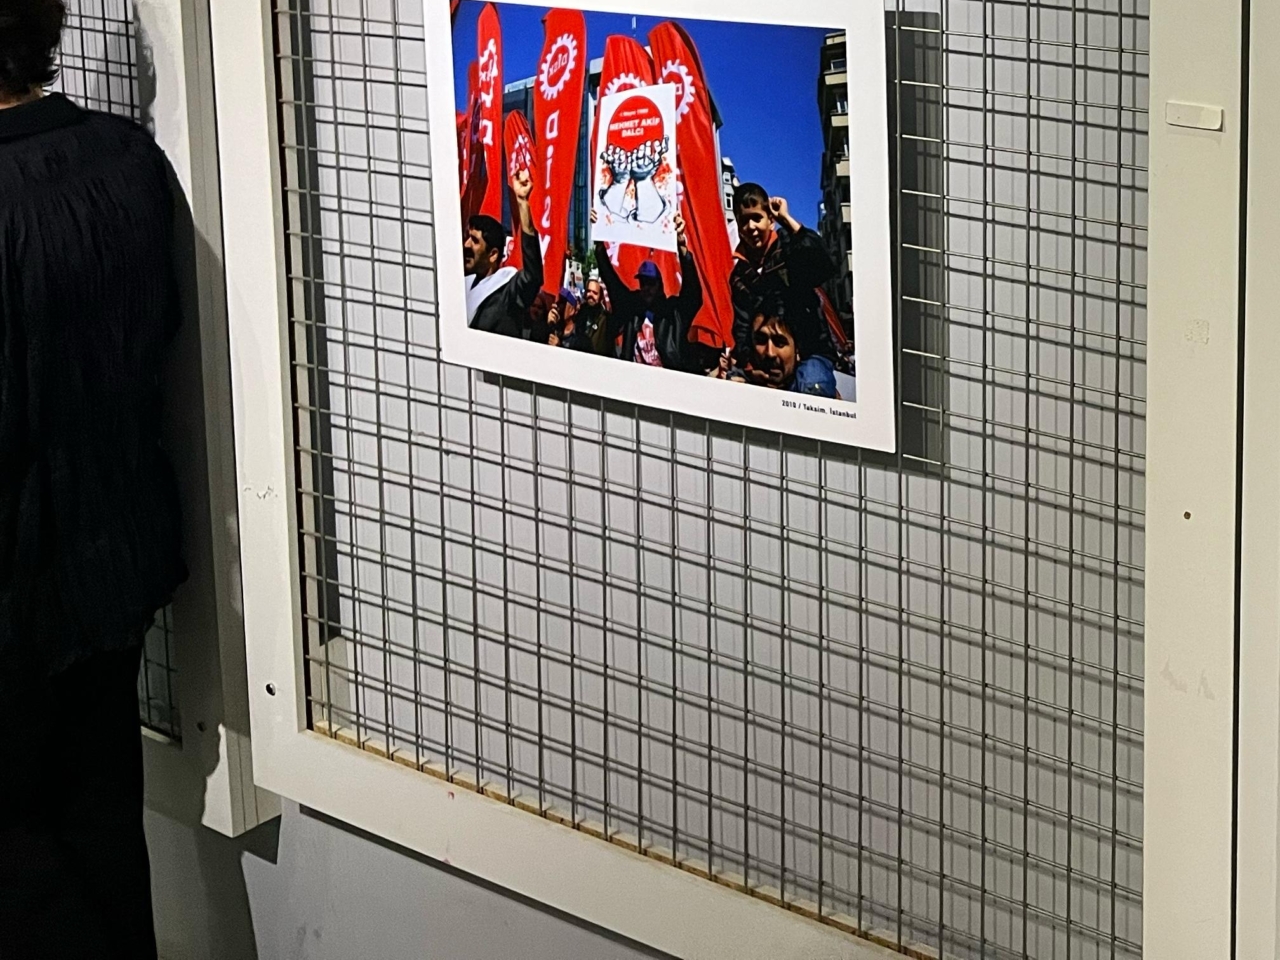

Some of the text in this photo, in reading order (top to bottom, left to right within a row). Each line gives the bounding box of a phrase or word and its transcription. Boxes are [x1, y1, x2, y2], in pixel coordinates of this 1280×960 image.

[609, 119, 640, 131] MEHMET
[782, 400, 797, 409] 2010
[829, 407, 857, 419] İstanbul
